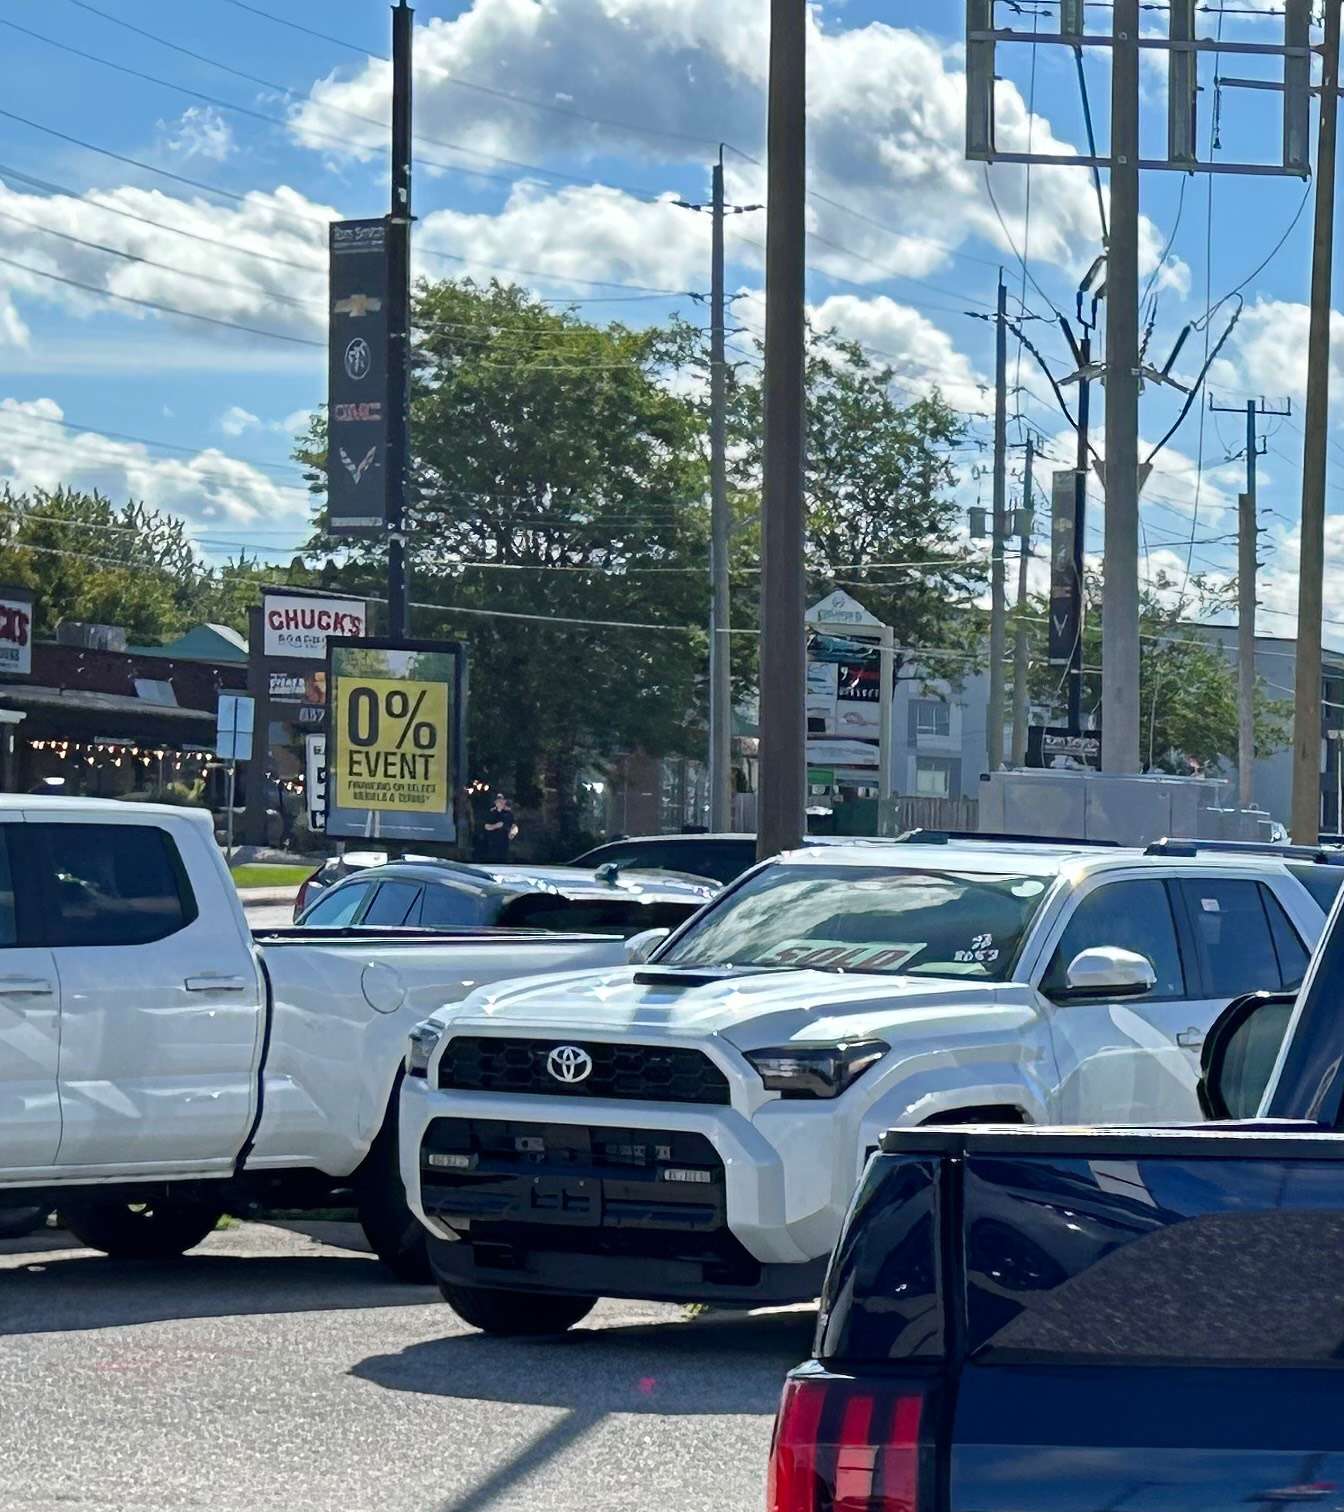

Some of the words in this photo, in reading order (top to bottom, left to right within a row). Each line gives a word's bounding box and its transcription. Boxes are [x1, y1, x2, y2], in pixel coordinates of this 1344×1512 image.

[268, 608, 363, 635] CHUCK'S
[347, 686, 437, 750] 0%
[349, 750, 435, 781] EVENT
[773, 946, 911, 970] SOLD
